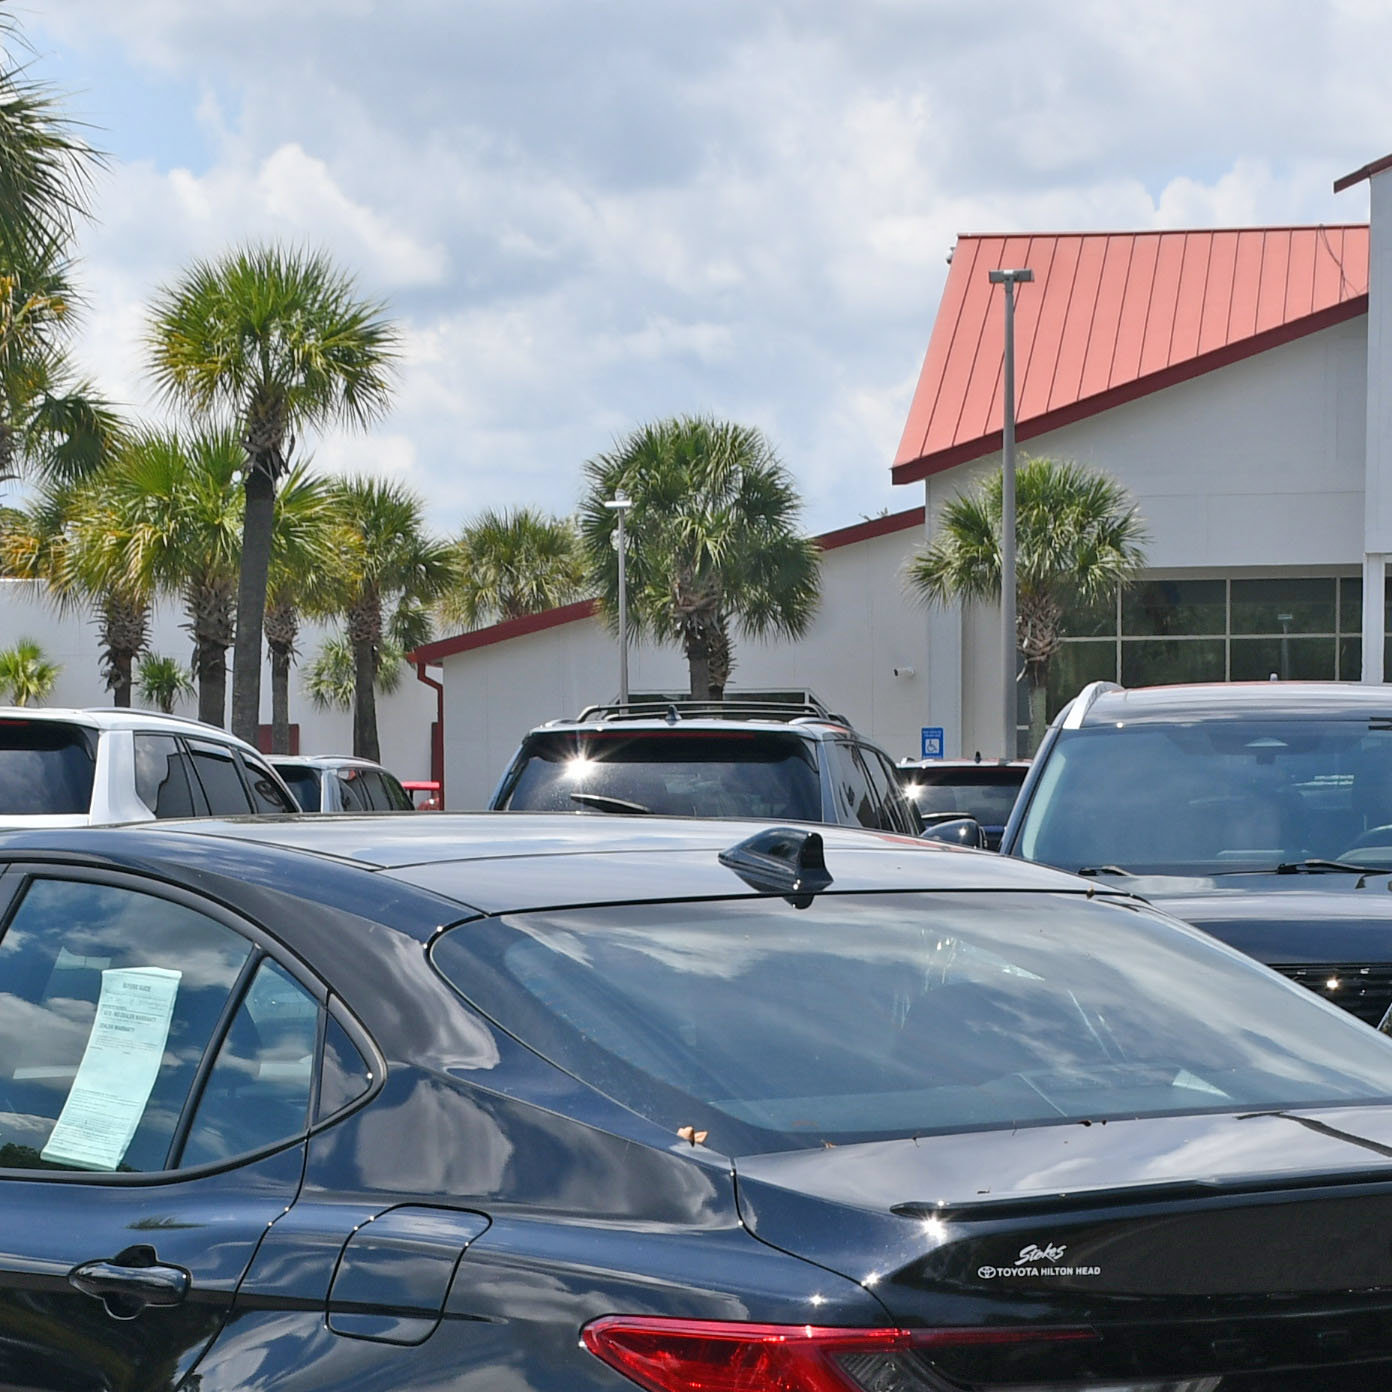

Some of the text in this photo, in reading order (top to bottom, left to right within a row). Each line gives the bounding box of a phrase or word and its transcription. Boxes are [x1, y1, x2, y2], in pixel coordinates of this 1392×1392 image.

[1014, 1241, 1067, 1266] Stokes
[996, 1266, 1101, 1277] TOYOTA HILTON HEAD
